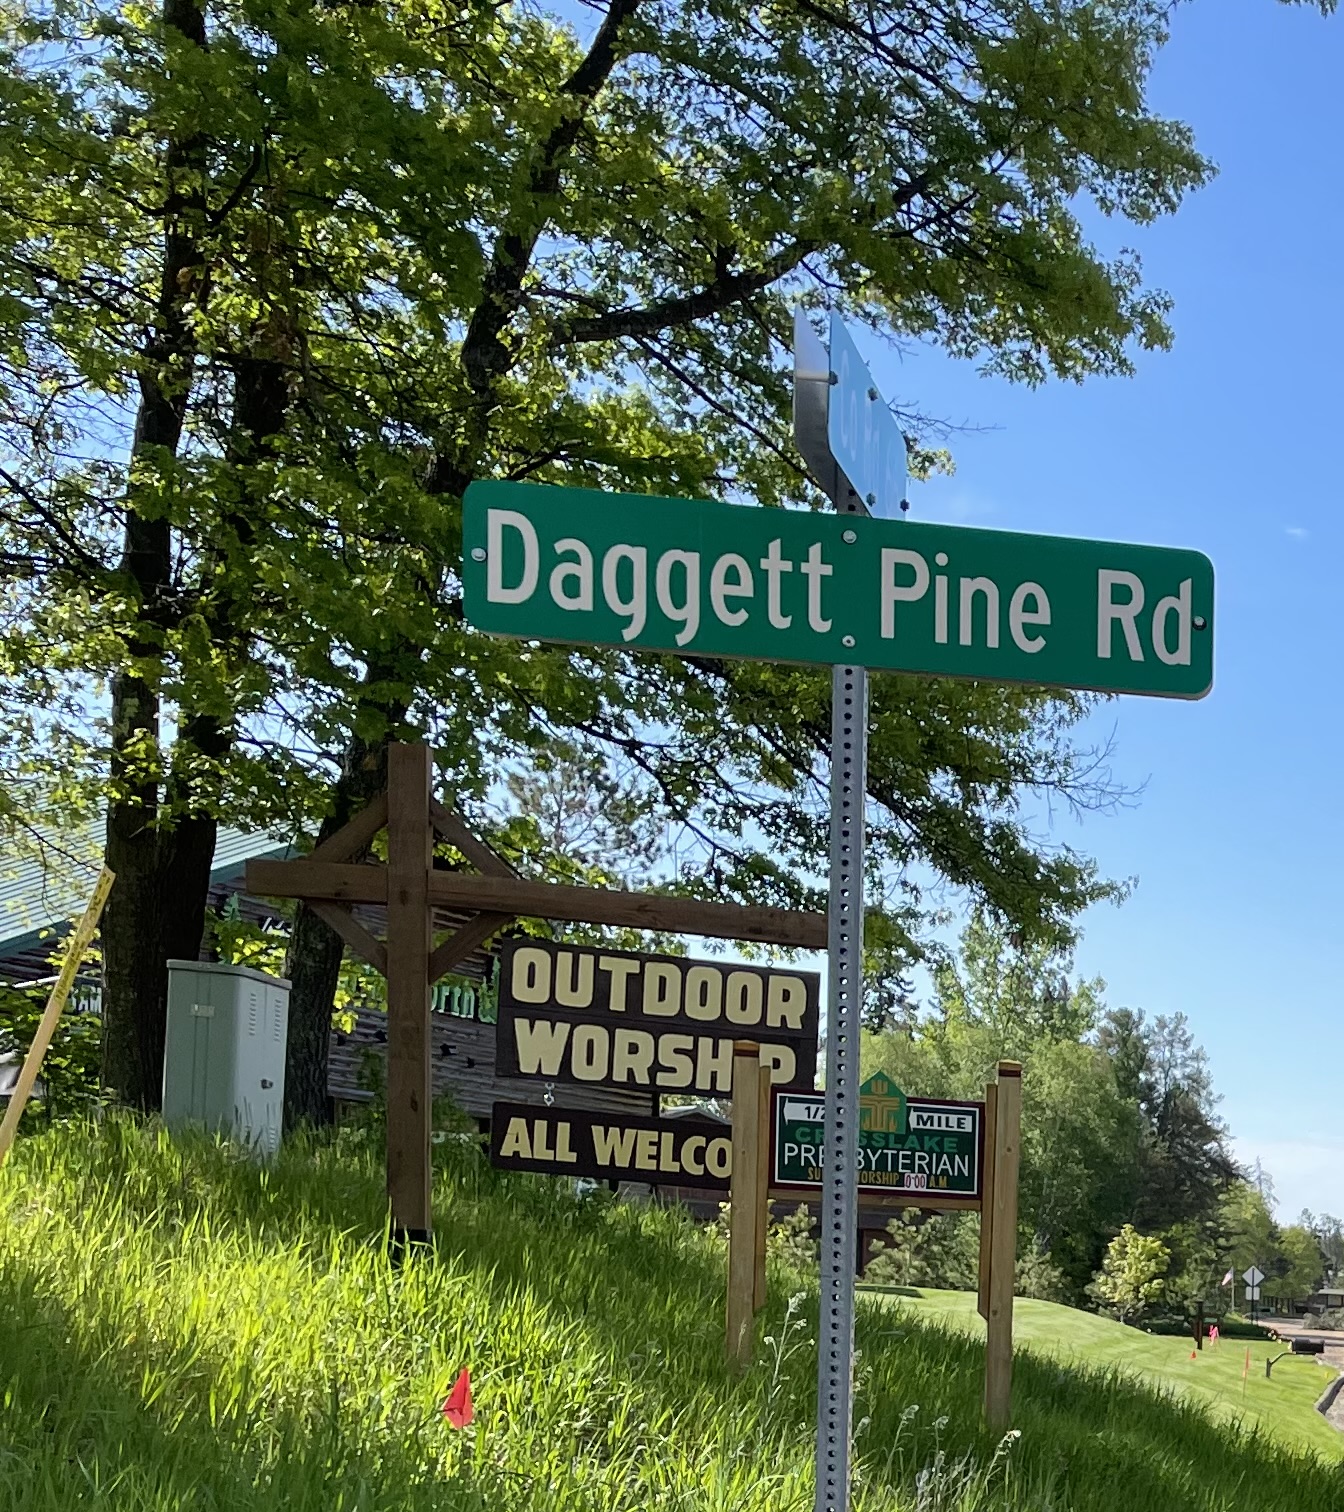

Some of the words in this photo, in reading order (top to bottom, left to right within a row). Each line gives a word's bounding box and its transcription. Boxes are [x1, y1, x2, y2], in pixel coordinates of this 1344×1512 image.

[486, 507, 834, 647] Daggett
[879, 546, 1052, 654] Pine
[1095, 567, 1192, 667] Rd
[511, 947, 807, 1030] OUTDOOR
[513, 1017, 797, 1092] WORSHP
[795, 1126, 958, 1153] CRSSLAKE
[915, 1113, 967, 1130] MILE
[499, 1116, 578, 1163] ALL
[591, 1124, 733, 1179] WELCO
[784, 1142, 969, 1177] PREBYTERIAN
[857, 1171, 899, 1186] ORSHIP
